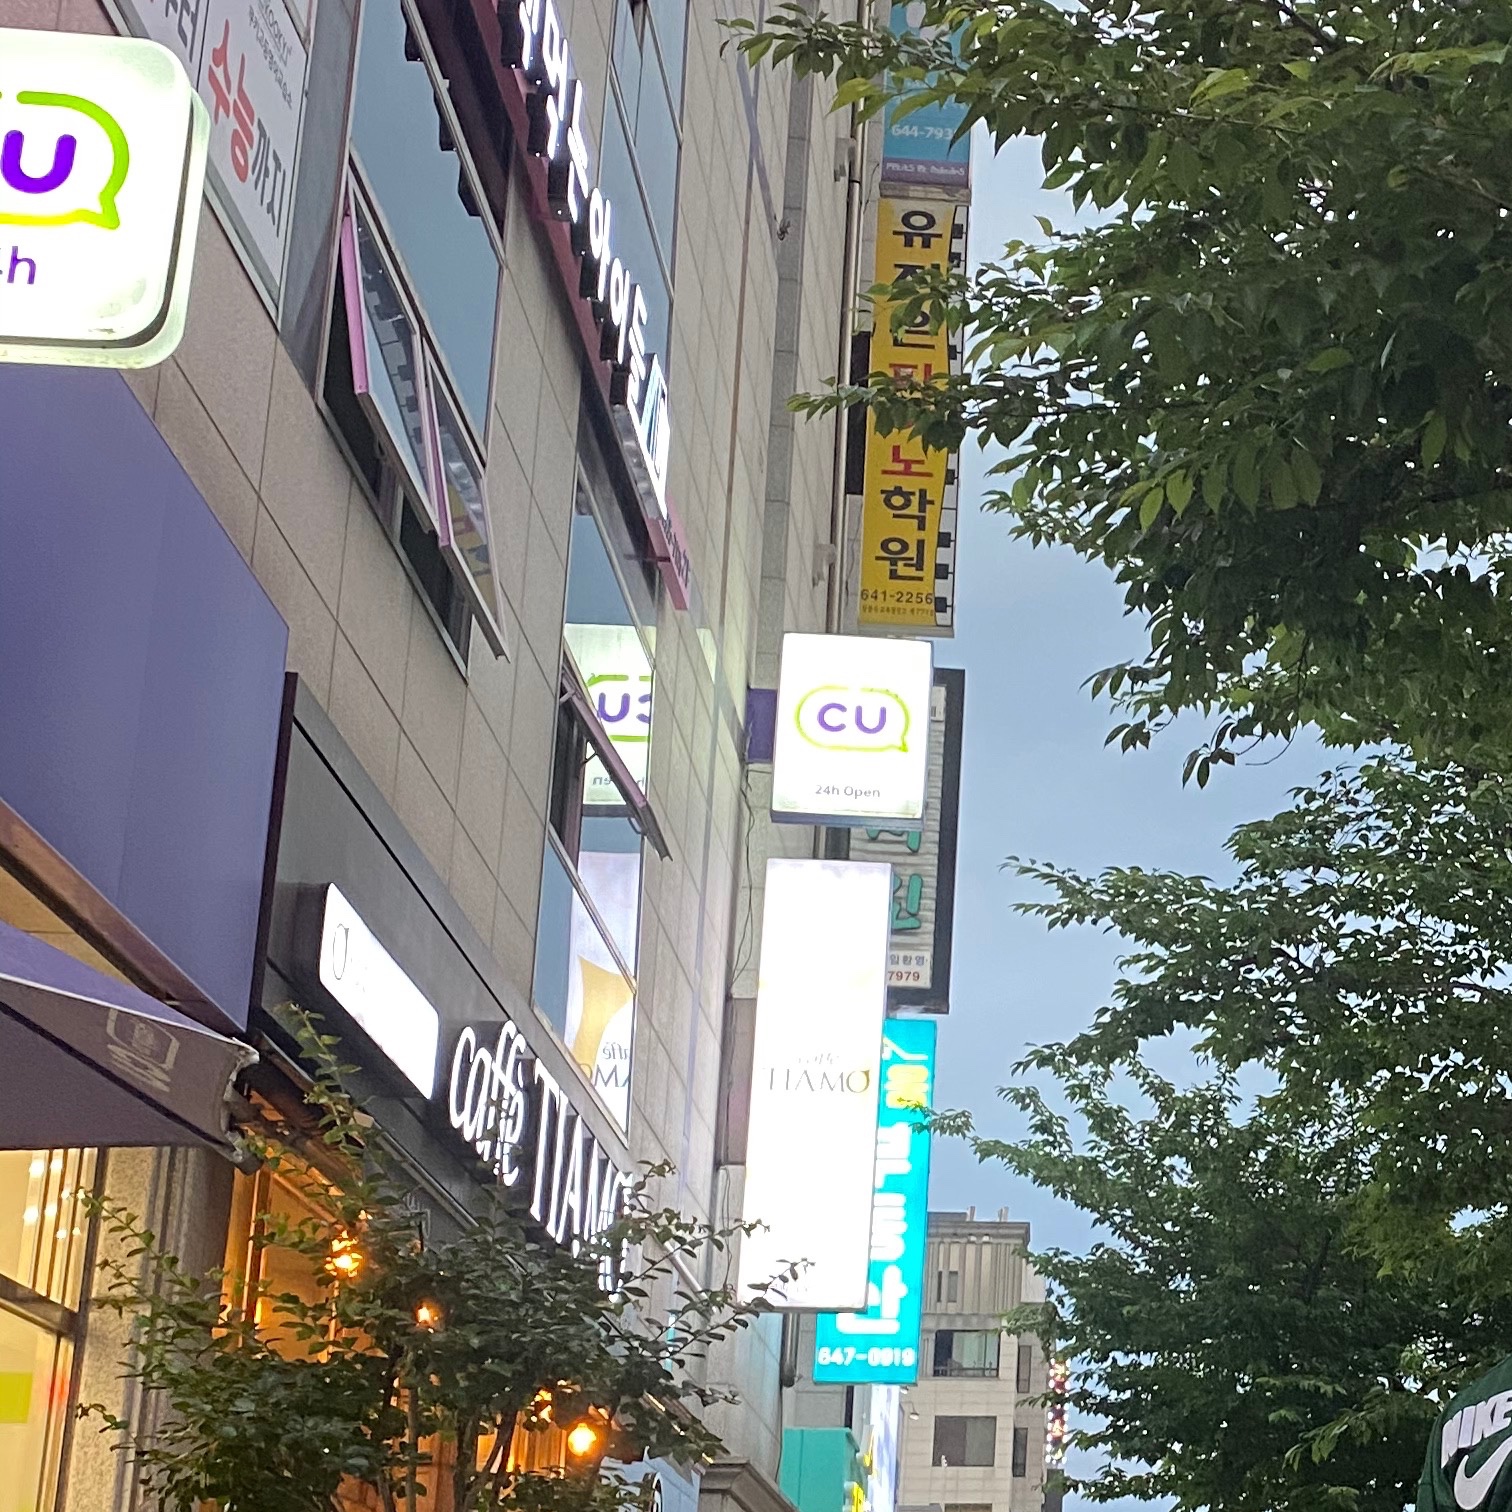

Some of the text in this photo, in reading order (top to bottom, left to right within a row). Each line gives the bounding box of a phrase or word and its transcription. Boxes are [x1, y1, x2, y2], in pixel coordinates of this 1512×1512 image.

[891, 123, 959, 141] 644-793
[861, 588, 934, 605] 641-2256
[817, 703, 887, 735] CU
[815, 784, 881, 799] 24h Open
